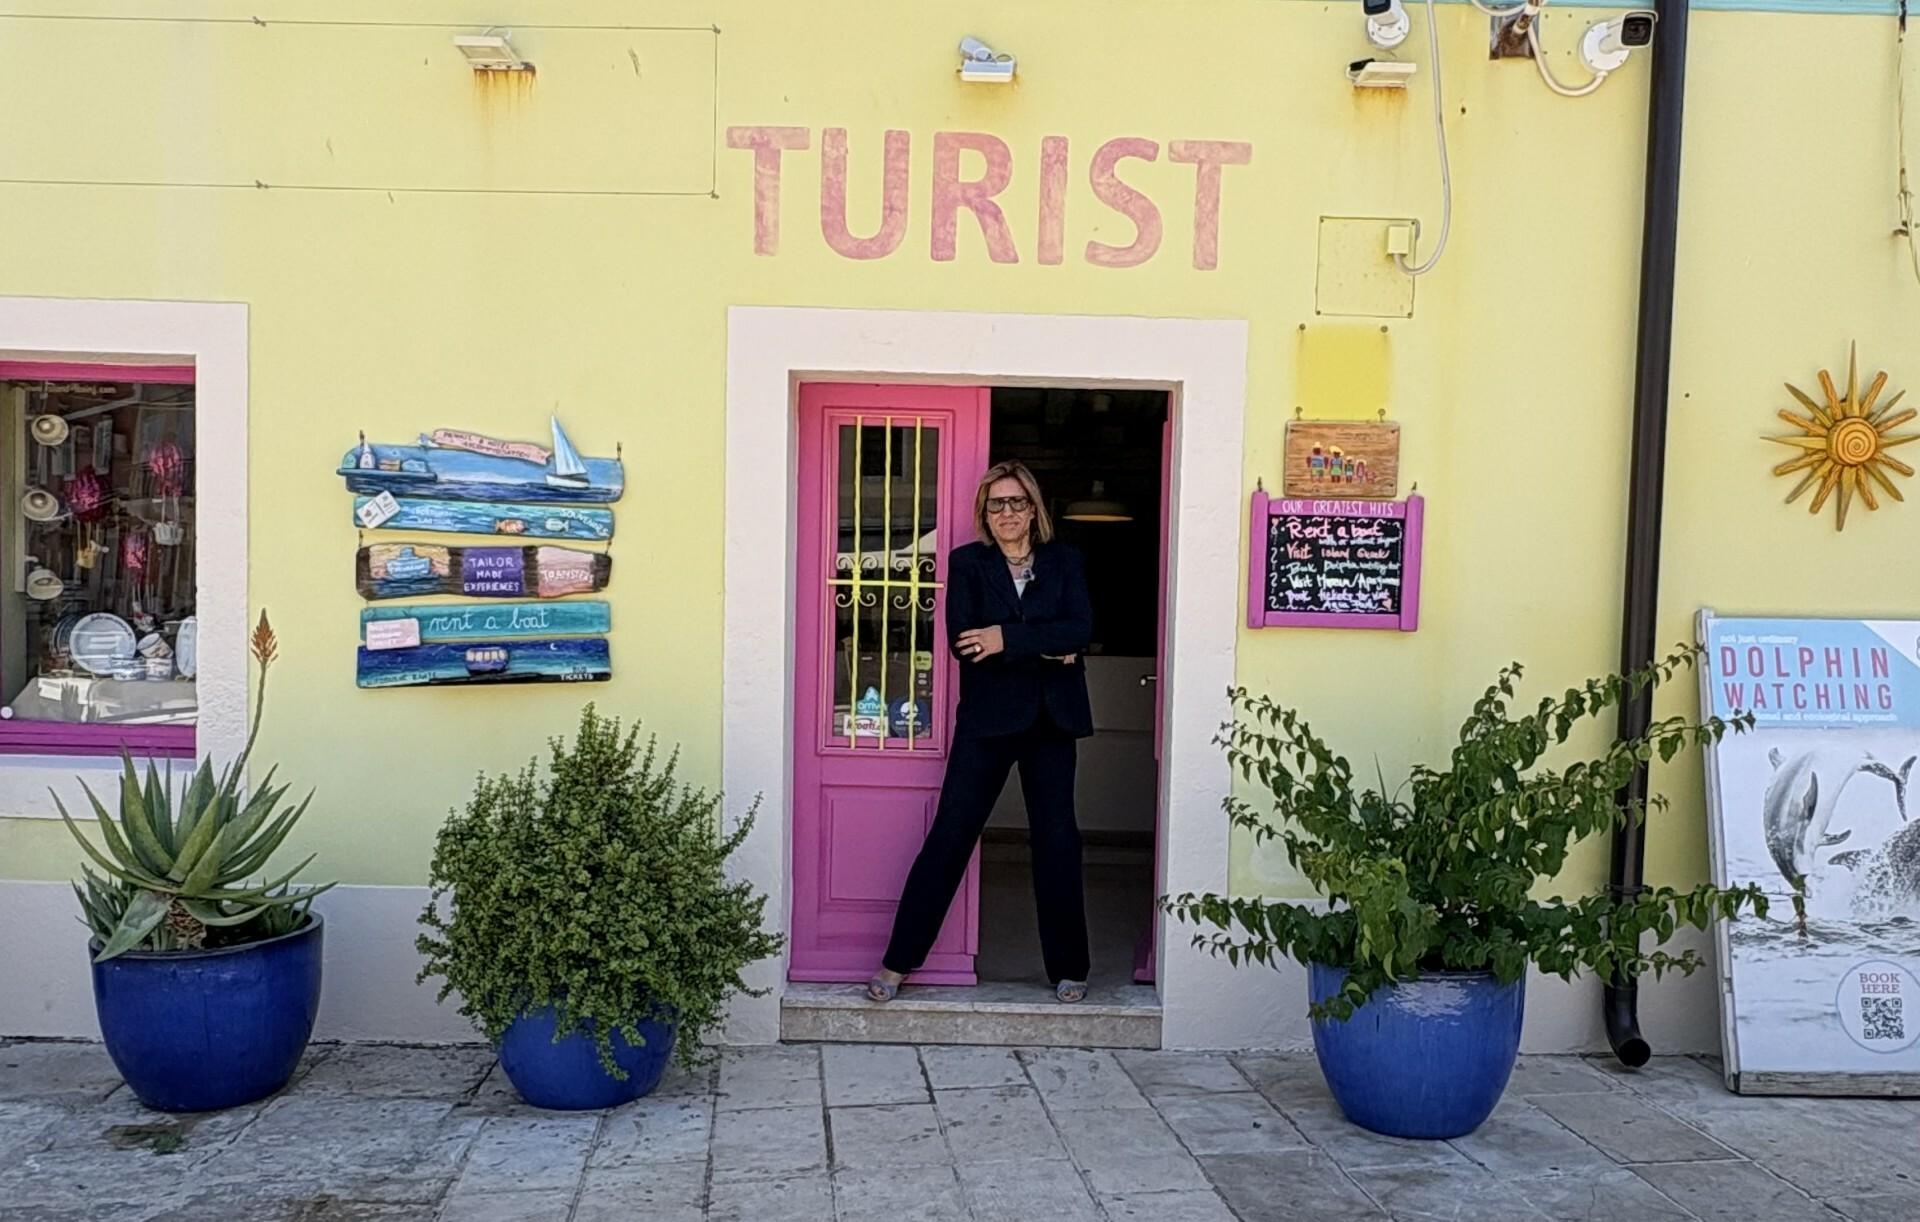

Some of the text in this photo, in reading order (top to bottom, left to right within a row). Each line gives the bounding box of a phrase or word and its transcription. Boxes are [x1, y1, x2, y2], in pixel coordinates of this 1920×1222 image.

[727, 126, 1252, 270] TURIST
[1282, 500, 1394, 516] OUR GREATEST HITS
[1286, 518, 1384, 539] Rent a boat
[1287, 541, 1312, 559] Visit
[468, 556, 514, 568] TAILOR
[476, 570, 503, 579] MADE
[463, 582, 520, 592] EXPERIENCES
[429, 608, 550, 632] rent a boat
[1720, 646, 1889, 678] DOLPHIN
[1723, 682, 1893, 710] WATCHING
[1859, 972, 1901, 984] BOOK
[1861, 983, 1900, 994] HERE
